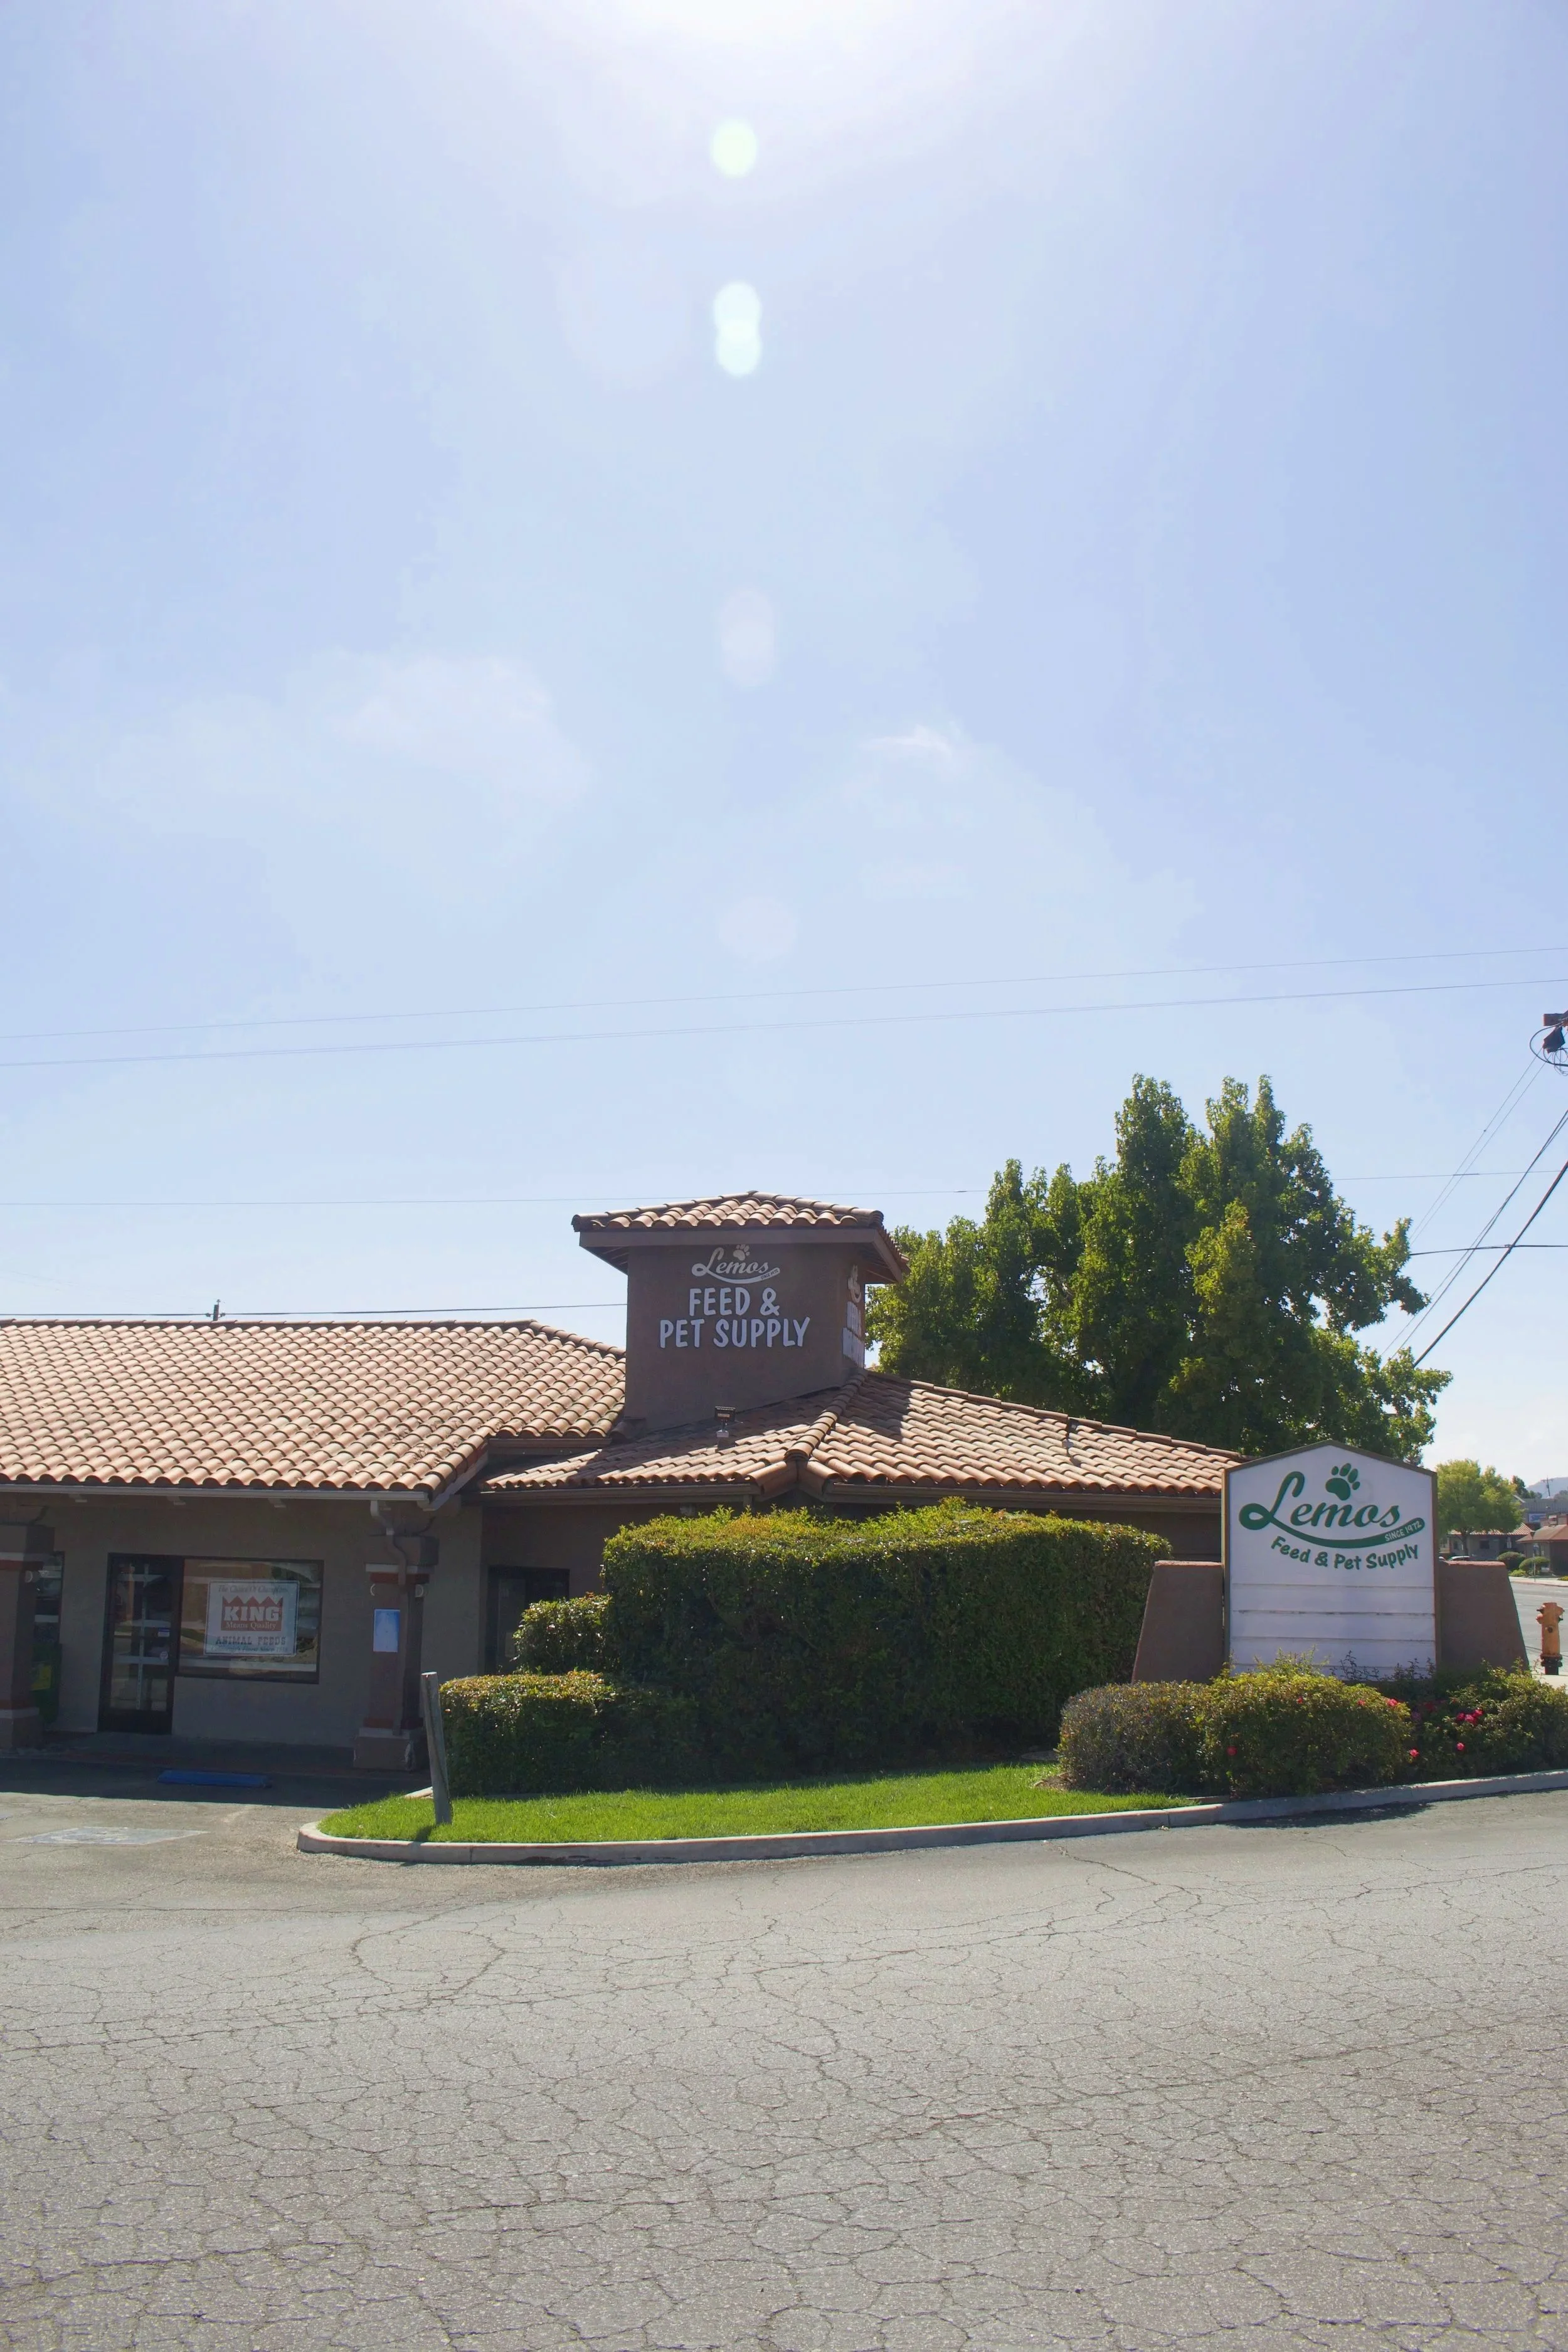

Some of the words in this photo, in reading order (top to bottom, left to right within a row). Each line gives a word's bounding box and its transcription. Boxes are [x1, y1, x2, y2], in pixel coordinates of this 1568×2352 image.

[691, 1247, 780, 1284] Lemos
[689, 1287, 751, 1316] FEED
[760, 1287, 780, 1316] &
[660, 1318, 705, 1348] PET
[713, 1316, 810, 1348] SUPPLY
[1239, 1471, 1425, 1549] Lemos
[1385, 1528, 1405, 1541] SINCE
[1405, 1520, 1422, 1534] 1972
[1271, 1536, 1310, 1563] Feed
[1315, 1552, 1328, 1567] &
[1334, 1554, 1360, 1569] Pet
[1366, 1544, 1418, 1568] Supply
[223, 1606, 280, 1621] KING
[226, 1621, 248, 1629] Means
[250, 1621, 277, 1630] Quality
[216, 1636, 252, 1645] ANIMAL
[258, 1636, 287, 1645] FEEDS
